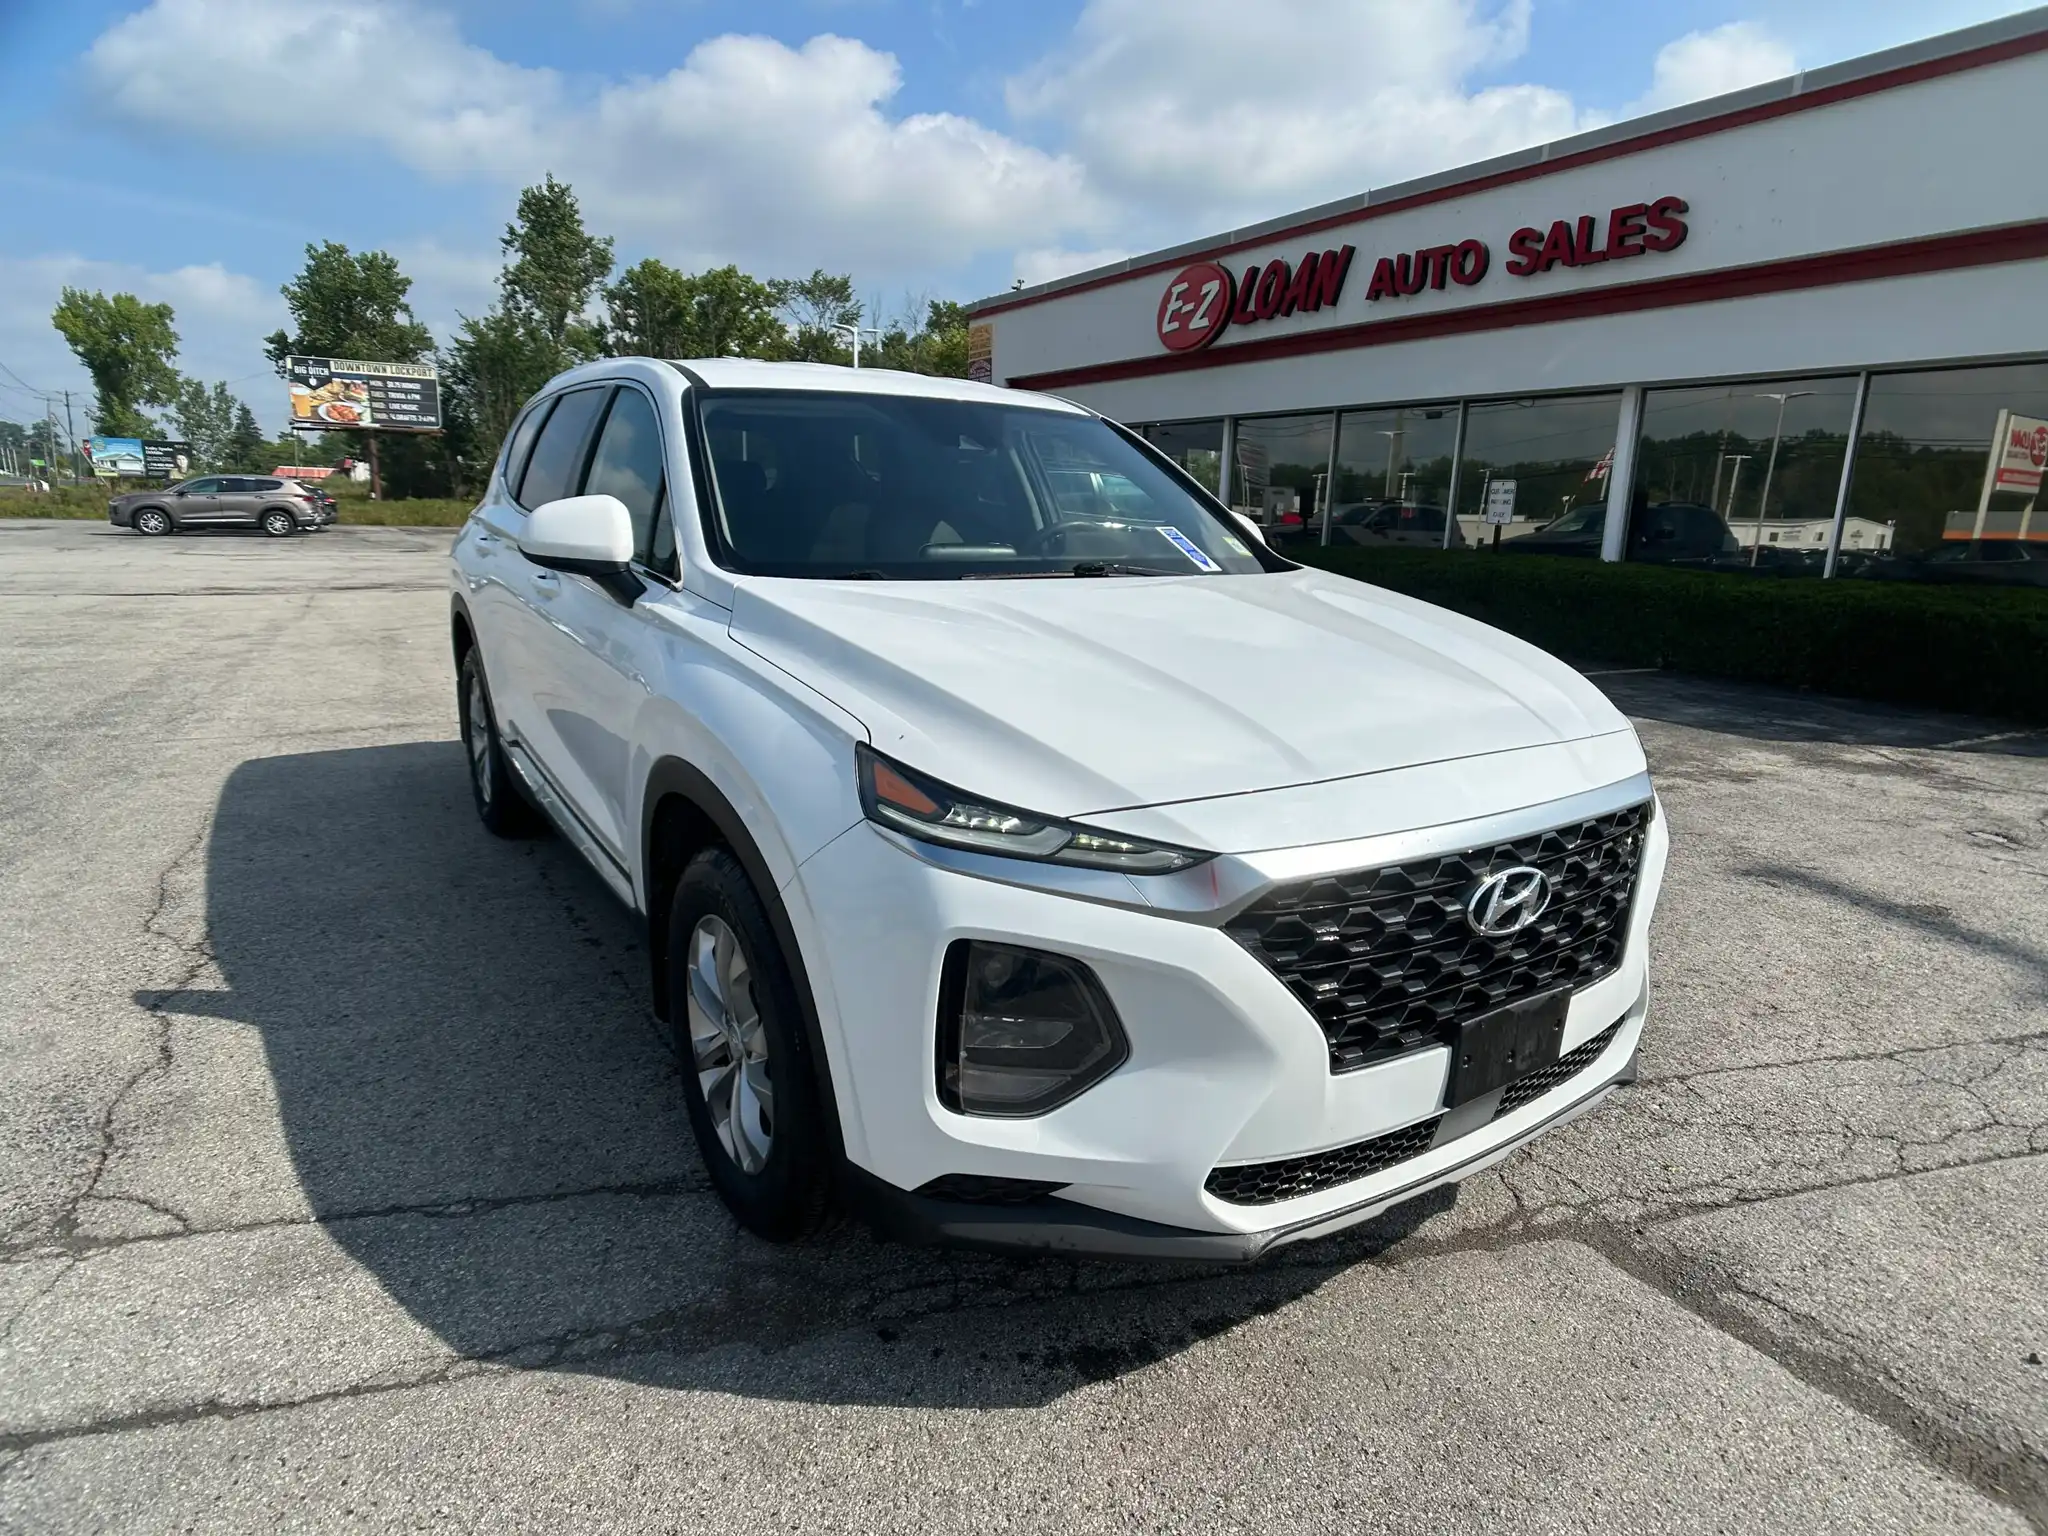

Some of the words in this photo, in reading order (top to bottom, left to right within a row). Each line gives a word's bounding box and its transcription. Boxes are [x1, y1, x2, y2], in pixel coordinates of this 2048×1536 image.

[1162, 279, 1220, 334] E-Z
[1231, 244, 1356, 325] LOAN
[1366, 238, 1490, 300] AUTO
[1506, 195, 1690, 276] SALES
[294, 365, 307, 374] BIG
[308, 367, 330, 376] DITCH
[333, 360, 387, 375] DOWNTOWN
[390, 366, 433, 378] LOCKPORT
